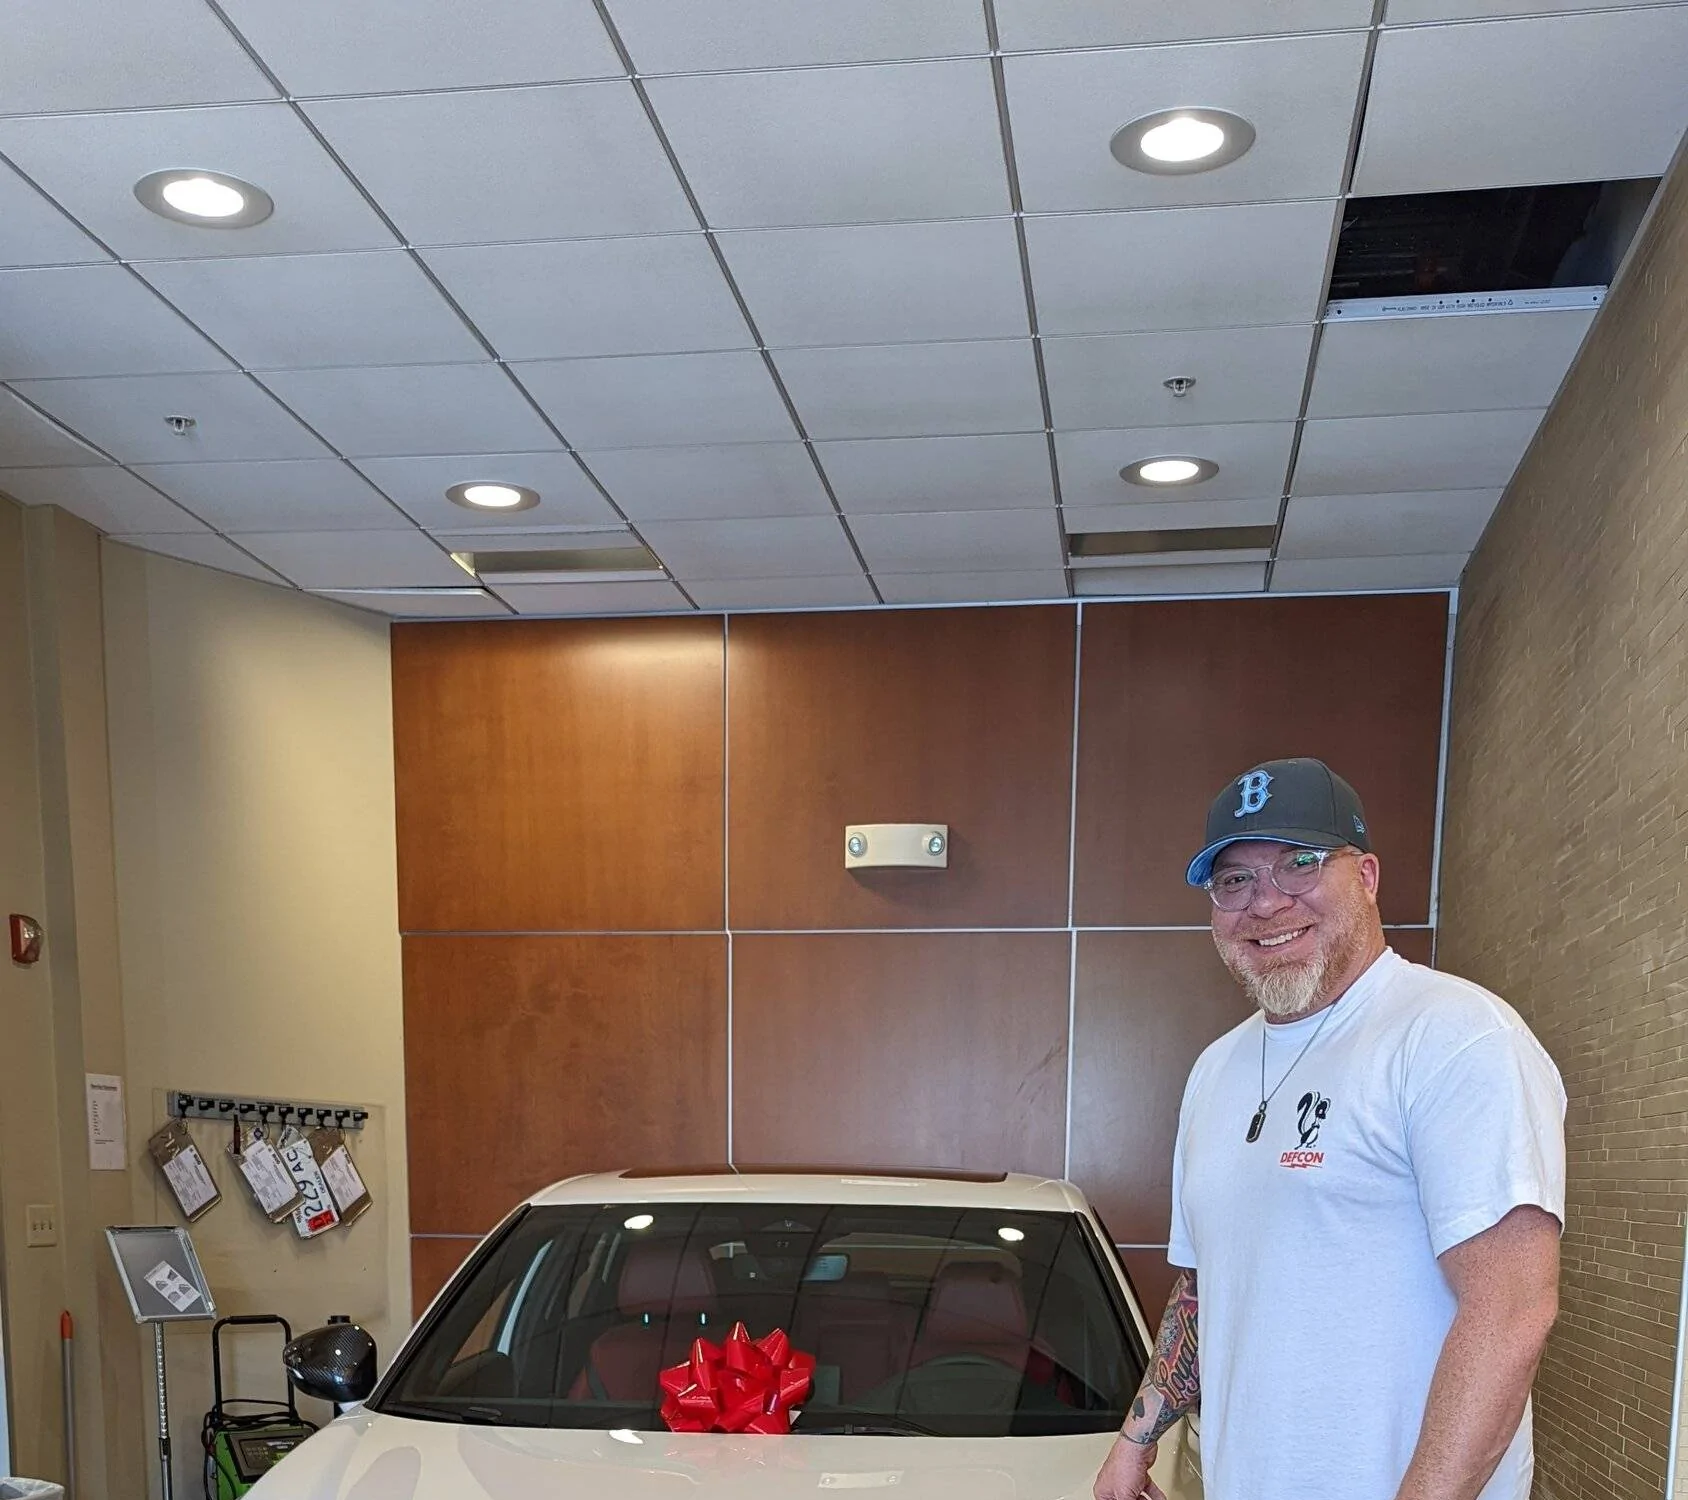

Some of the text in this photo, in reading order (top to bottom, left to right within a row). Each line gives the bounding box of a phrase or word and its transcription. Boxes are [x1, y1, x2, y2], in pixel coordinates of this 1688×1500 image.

[1234, 770, 1275, 818] B
[287, 1149, 305, 1172] AC
[1280, 1151, 1325, 1164] DEFCON
